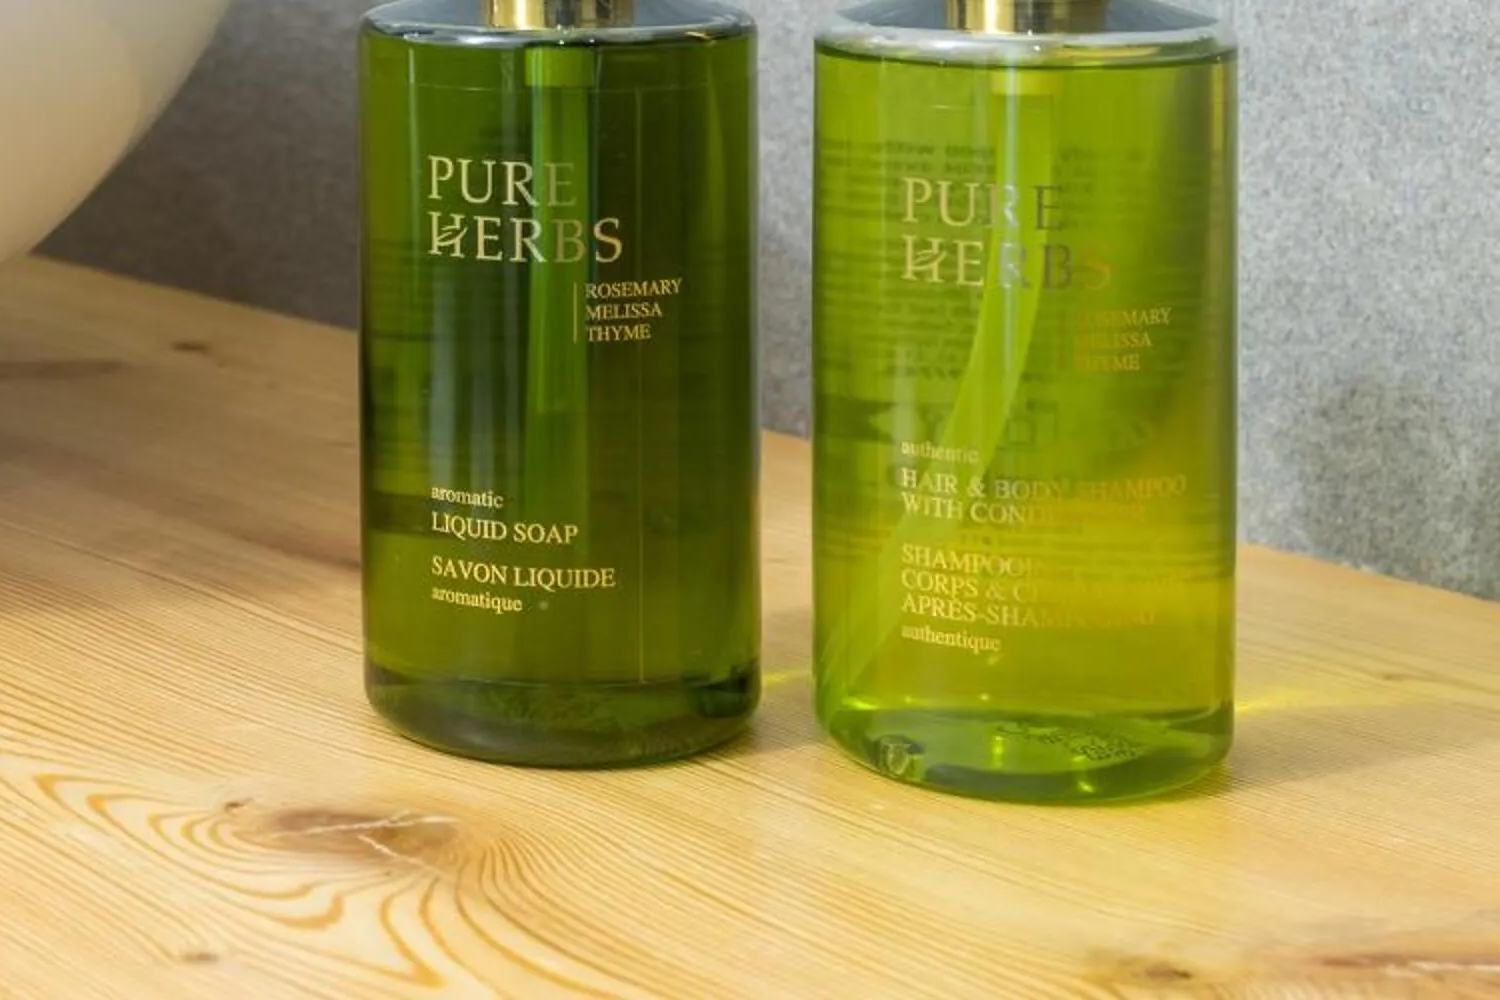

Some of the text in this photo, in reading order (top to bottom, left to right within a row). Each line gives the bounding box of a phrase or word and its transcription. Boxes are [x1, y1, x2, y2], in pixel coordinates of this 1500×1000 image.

[427, 154, 576, 207] PURE
[901, 176, 1067, 231] PURE
[427, 210, 623, 263] HERBS
[900, 234, 1112, 291] HERBS
[586, 278, 683, 299] ROSEMARY
[585, 302, 663, 321] MELISSA
[586, 323, 652, 342] THYME
[901, 440, 980, 464] authentic
[431, 486, 504, 509] aromatic
[901, 466, 958, 495] HAIR
[966, 478, 986, 499] &
[994, 479, 1063, 501] BODY
[901, 491, 963, 521] WITH
[431, 511, 579, 545] LIQUID SOAP
[431, 554, 617, 592] SAVON LIQUIDE
[901, 569, 978, 598] CORPS
[985, 581, 1005, 601] &
[431, 586, 523, 615] aromatique
[901, 624, 1000, 655] authentique
